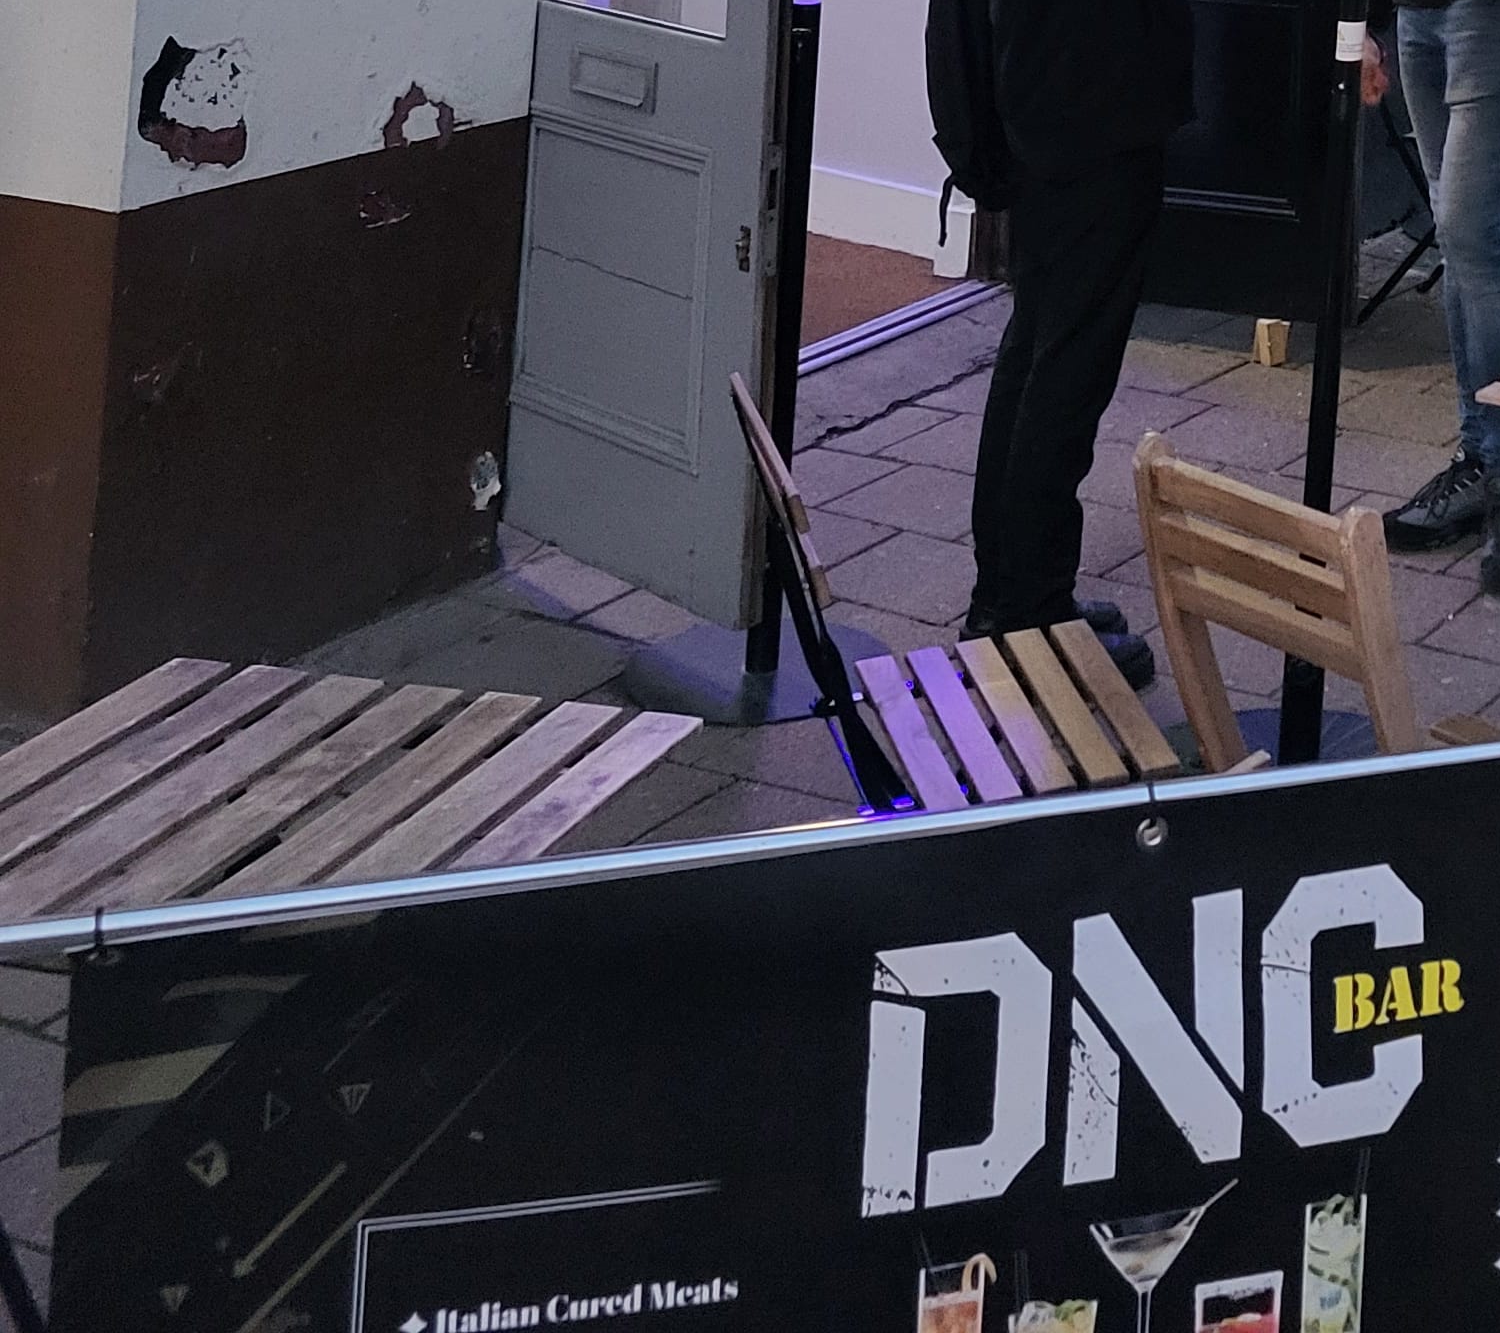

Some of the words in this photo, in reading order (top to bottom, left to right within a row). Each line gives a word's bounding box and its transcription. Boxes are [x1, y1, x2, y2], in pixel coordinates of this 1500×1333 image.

[1333, 959, 1465, 1034] BAR
[861, 863, 1425, 1219] DNC
[435, 1300, 541, 1333] Italian
[545, 1283, 643, 1323] Cured
[649, 1276, 740, 1311] Meats
